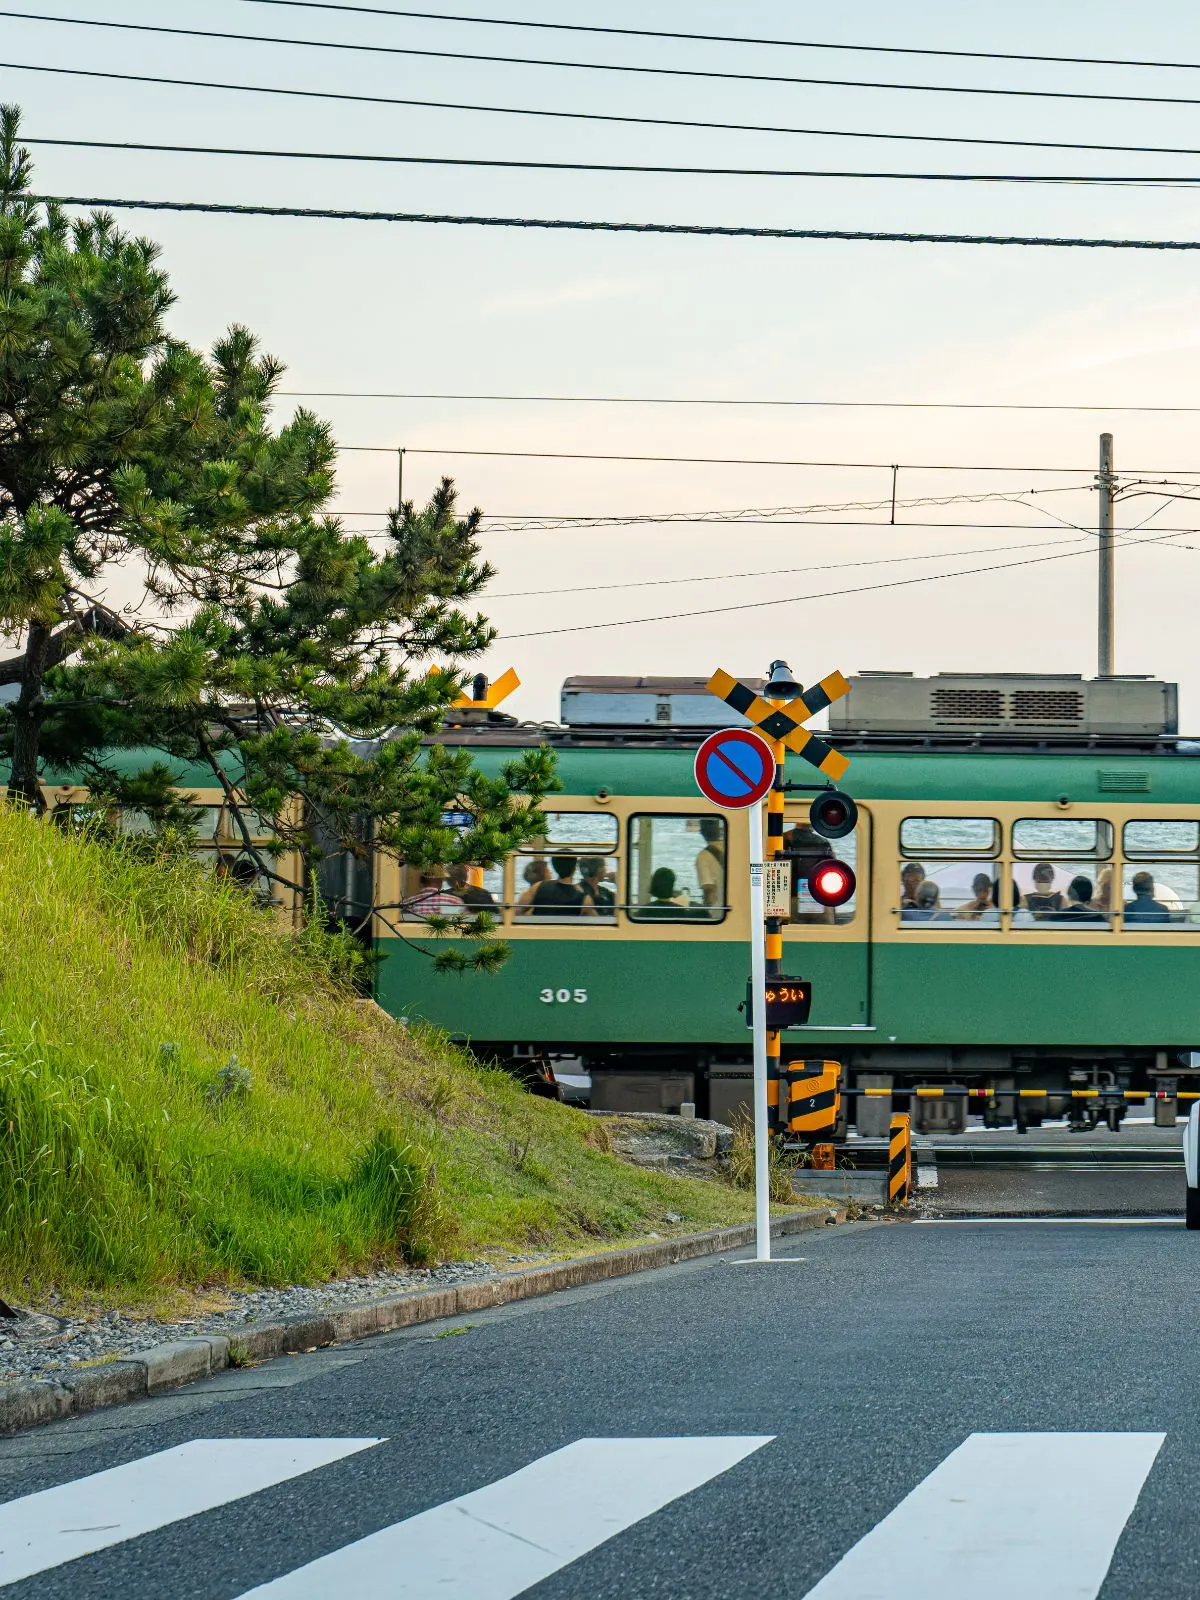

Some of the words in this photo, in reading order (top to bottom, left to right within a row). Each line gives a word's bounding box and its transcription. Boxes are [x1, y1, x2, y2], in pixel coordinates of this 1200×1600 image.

[539, 988, 588, 1003] 305
[765, 987, 804, 1002] ゅうい
[809, 1098, 815, 1108] 2
